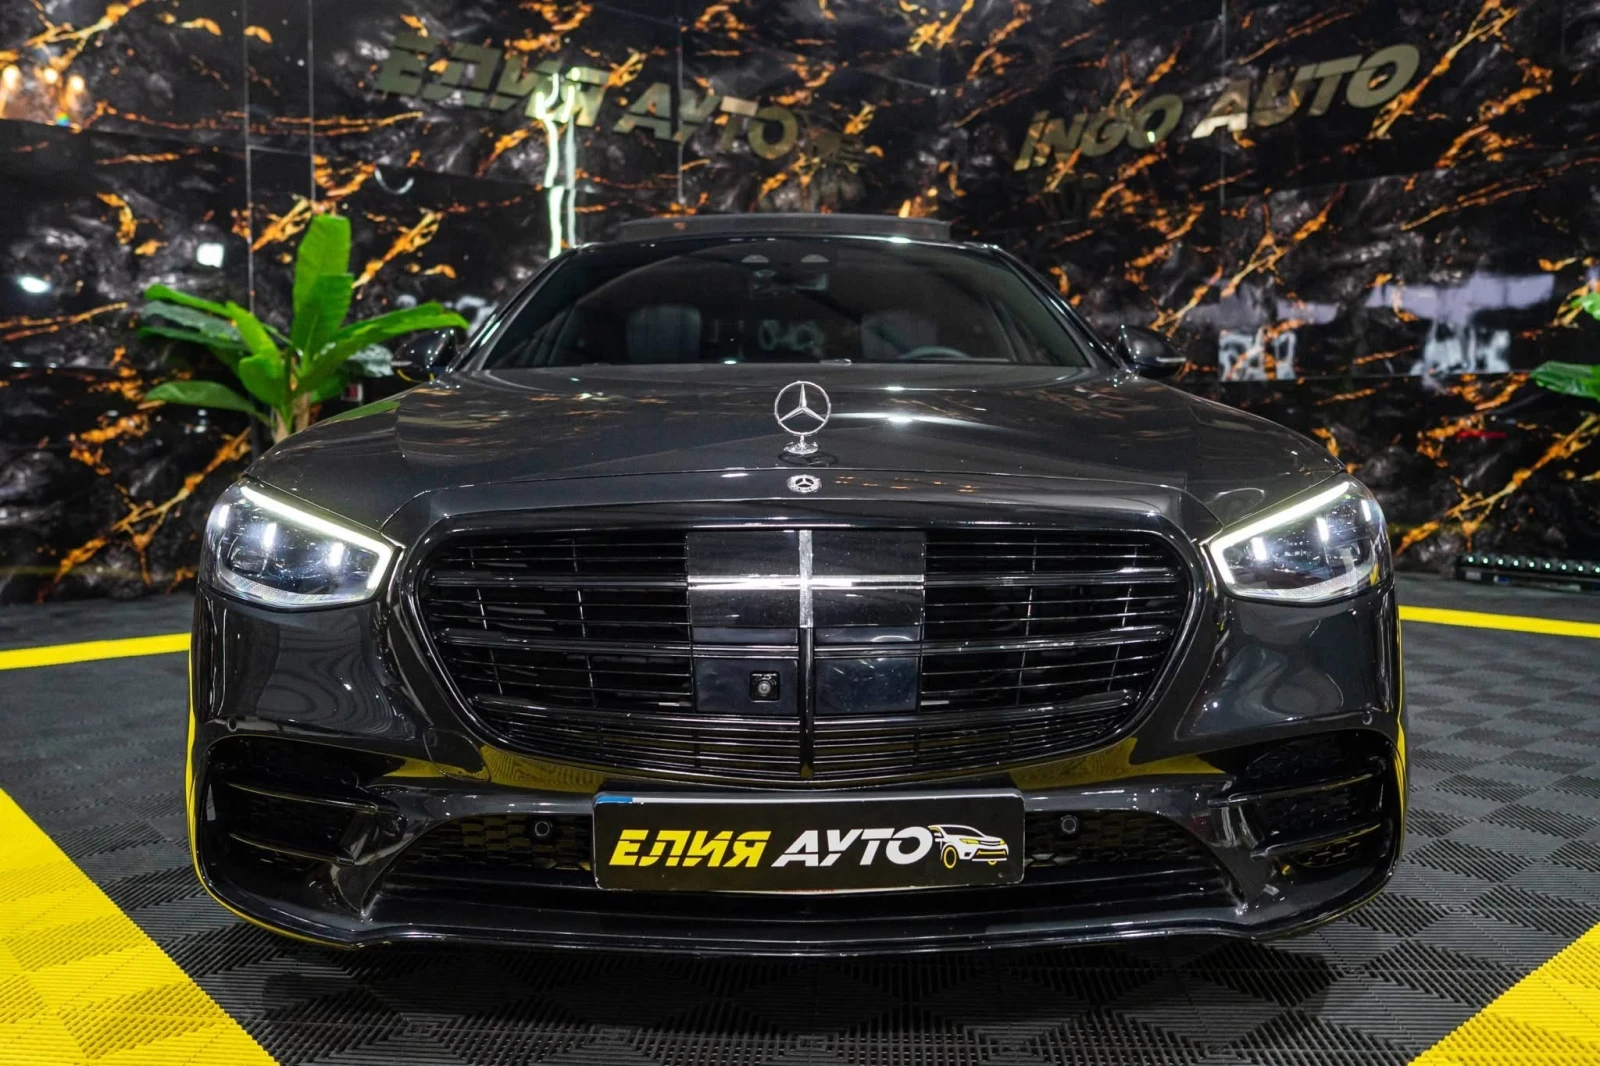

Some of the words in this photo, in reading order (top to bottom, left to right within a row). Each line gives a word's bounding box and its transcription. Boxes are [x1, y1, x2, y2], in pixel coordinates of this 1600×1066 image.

[612, 81, 798, 160] АУТО
[1013, 93, 1184, 172] INGO
[1191, 43, 1421, 140] AUTO
[608, 828, 772, 868] ЕЛИЯ
[770, 825, 935, 868] АУТО
